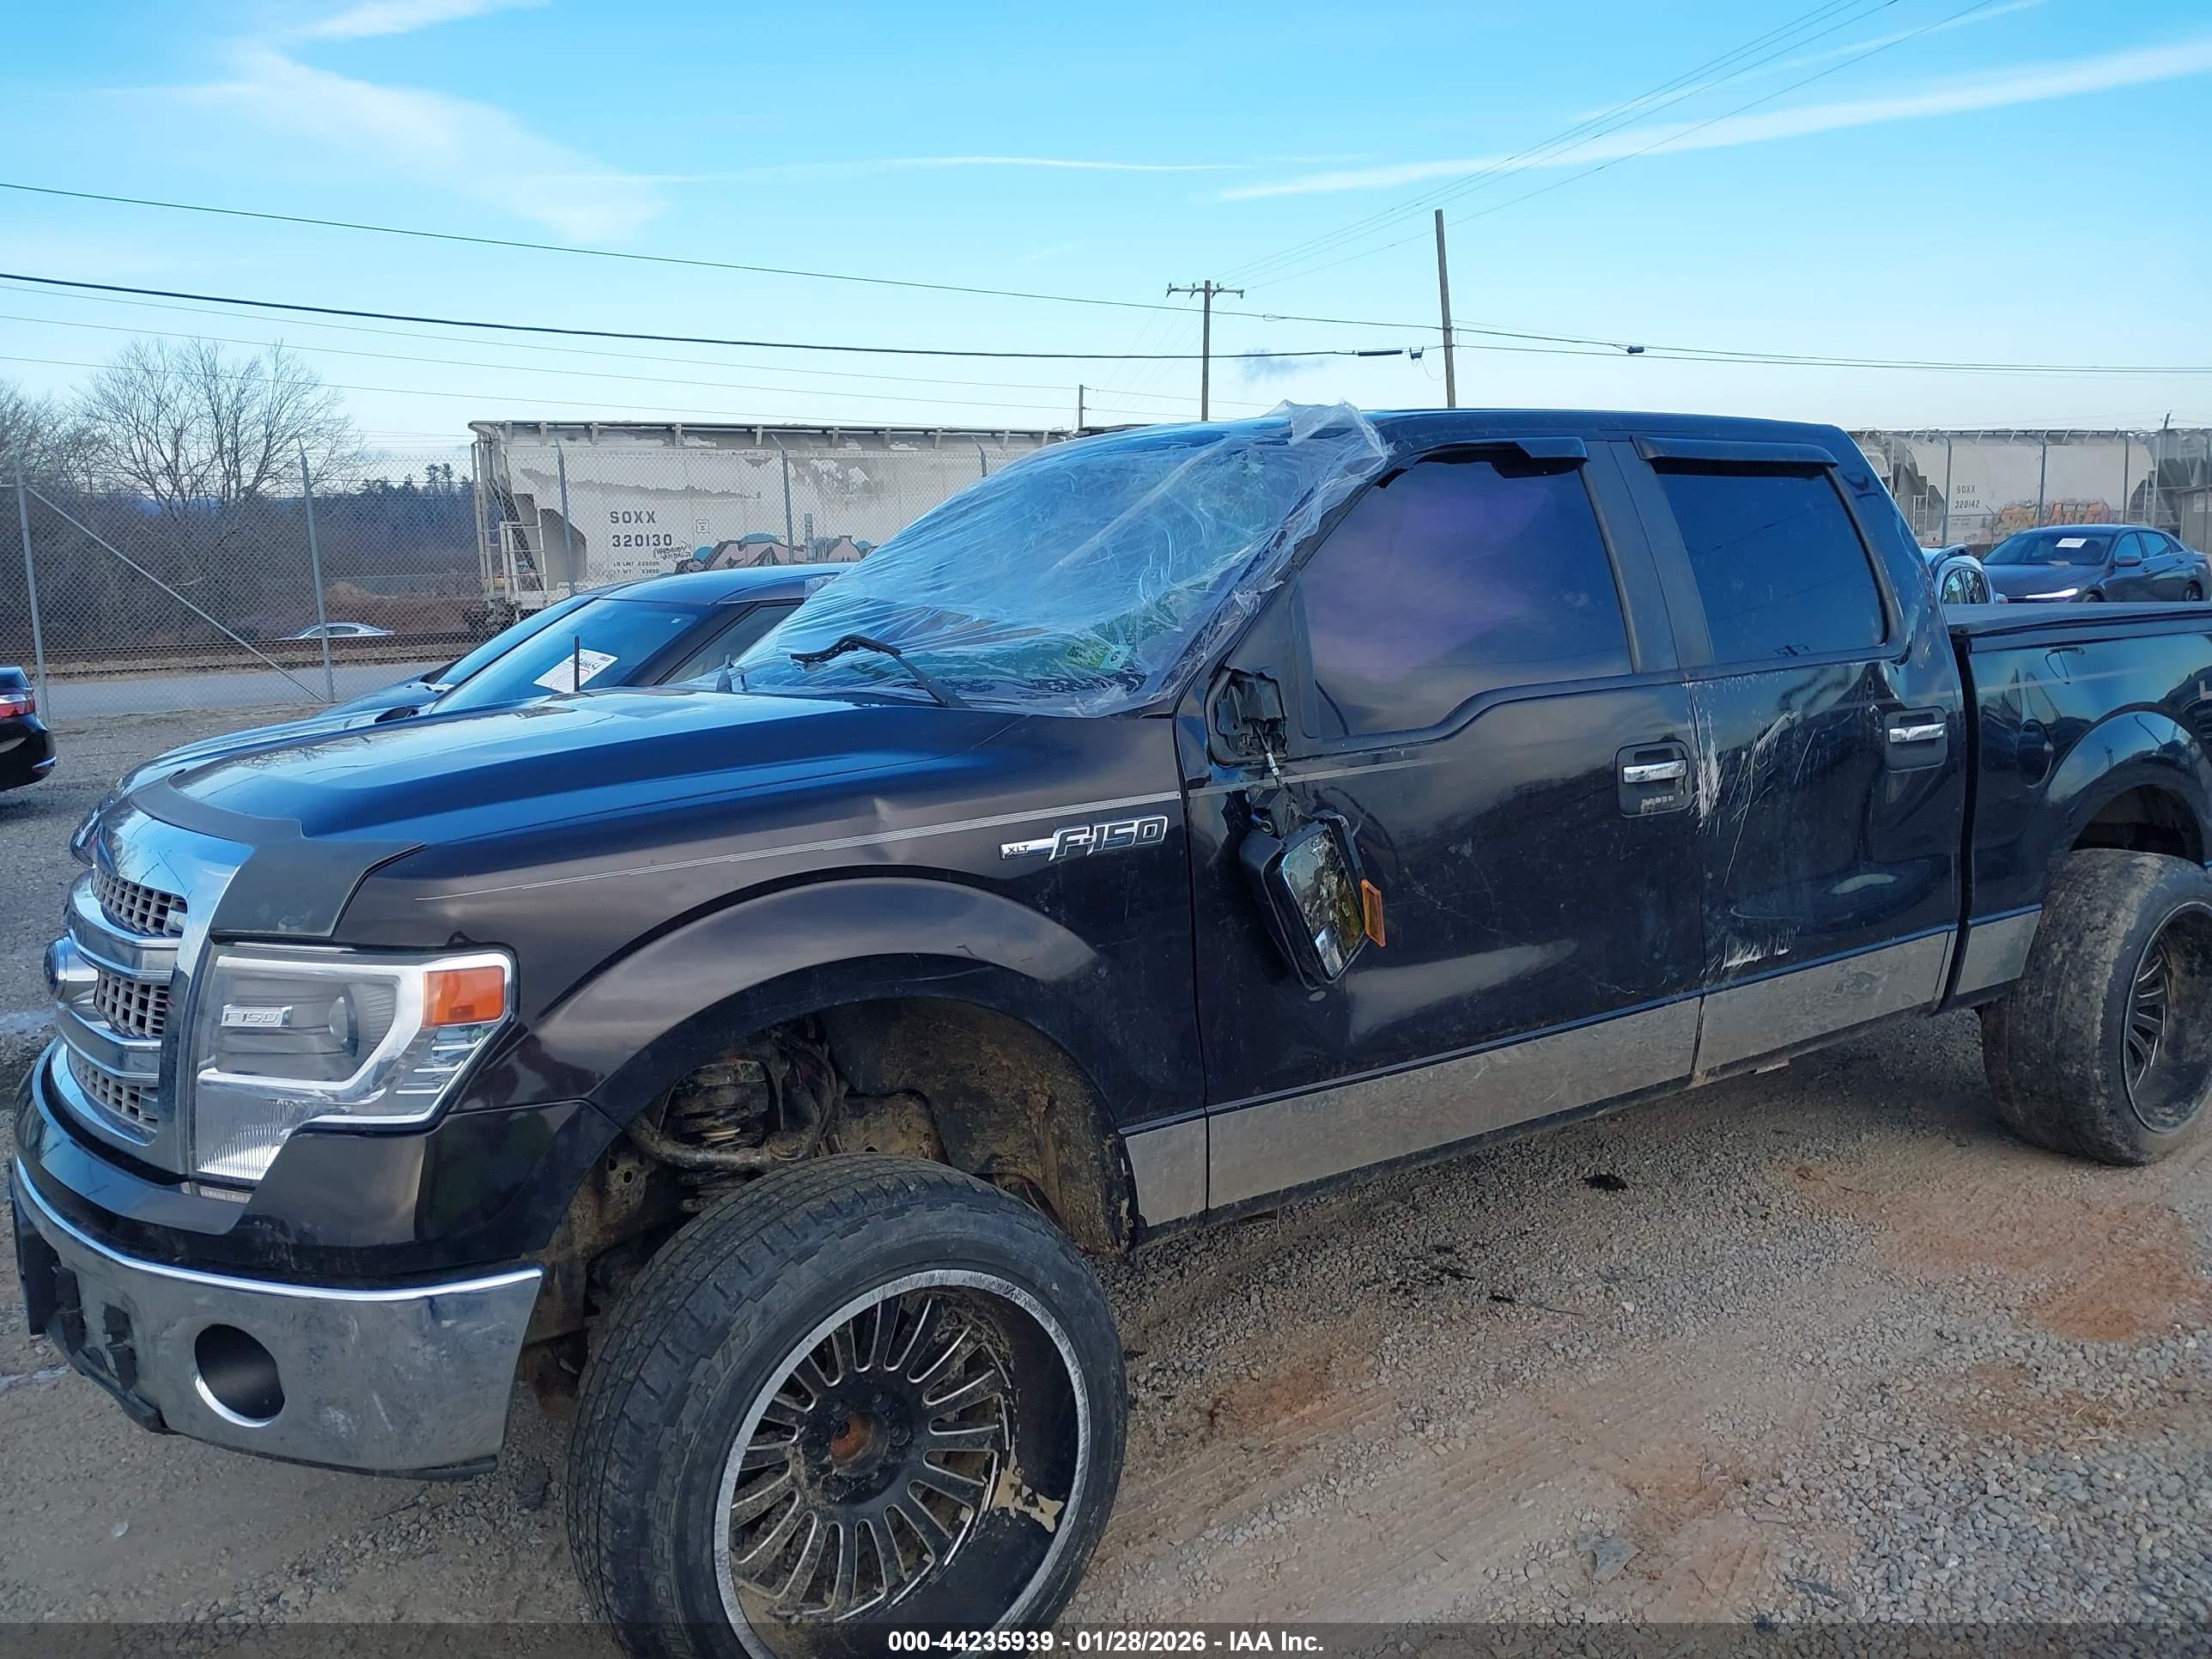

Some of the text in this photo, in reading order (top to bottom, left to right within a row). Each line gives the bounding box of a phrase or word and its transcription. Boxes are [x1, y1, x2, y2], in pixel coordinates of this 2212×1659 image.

[1956, 484, 1976, 495] SOXX
[610, 510, 656, 524] SOXX
[611, 533, 672, 548] 320130
[1048, 814, 1169, 862] F-150
[1007, 843, 1030, 855] XLT
